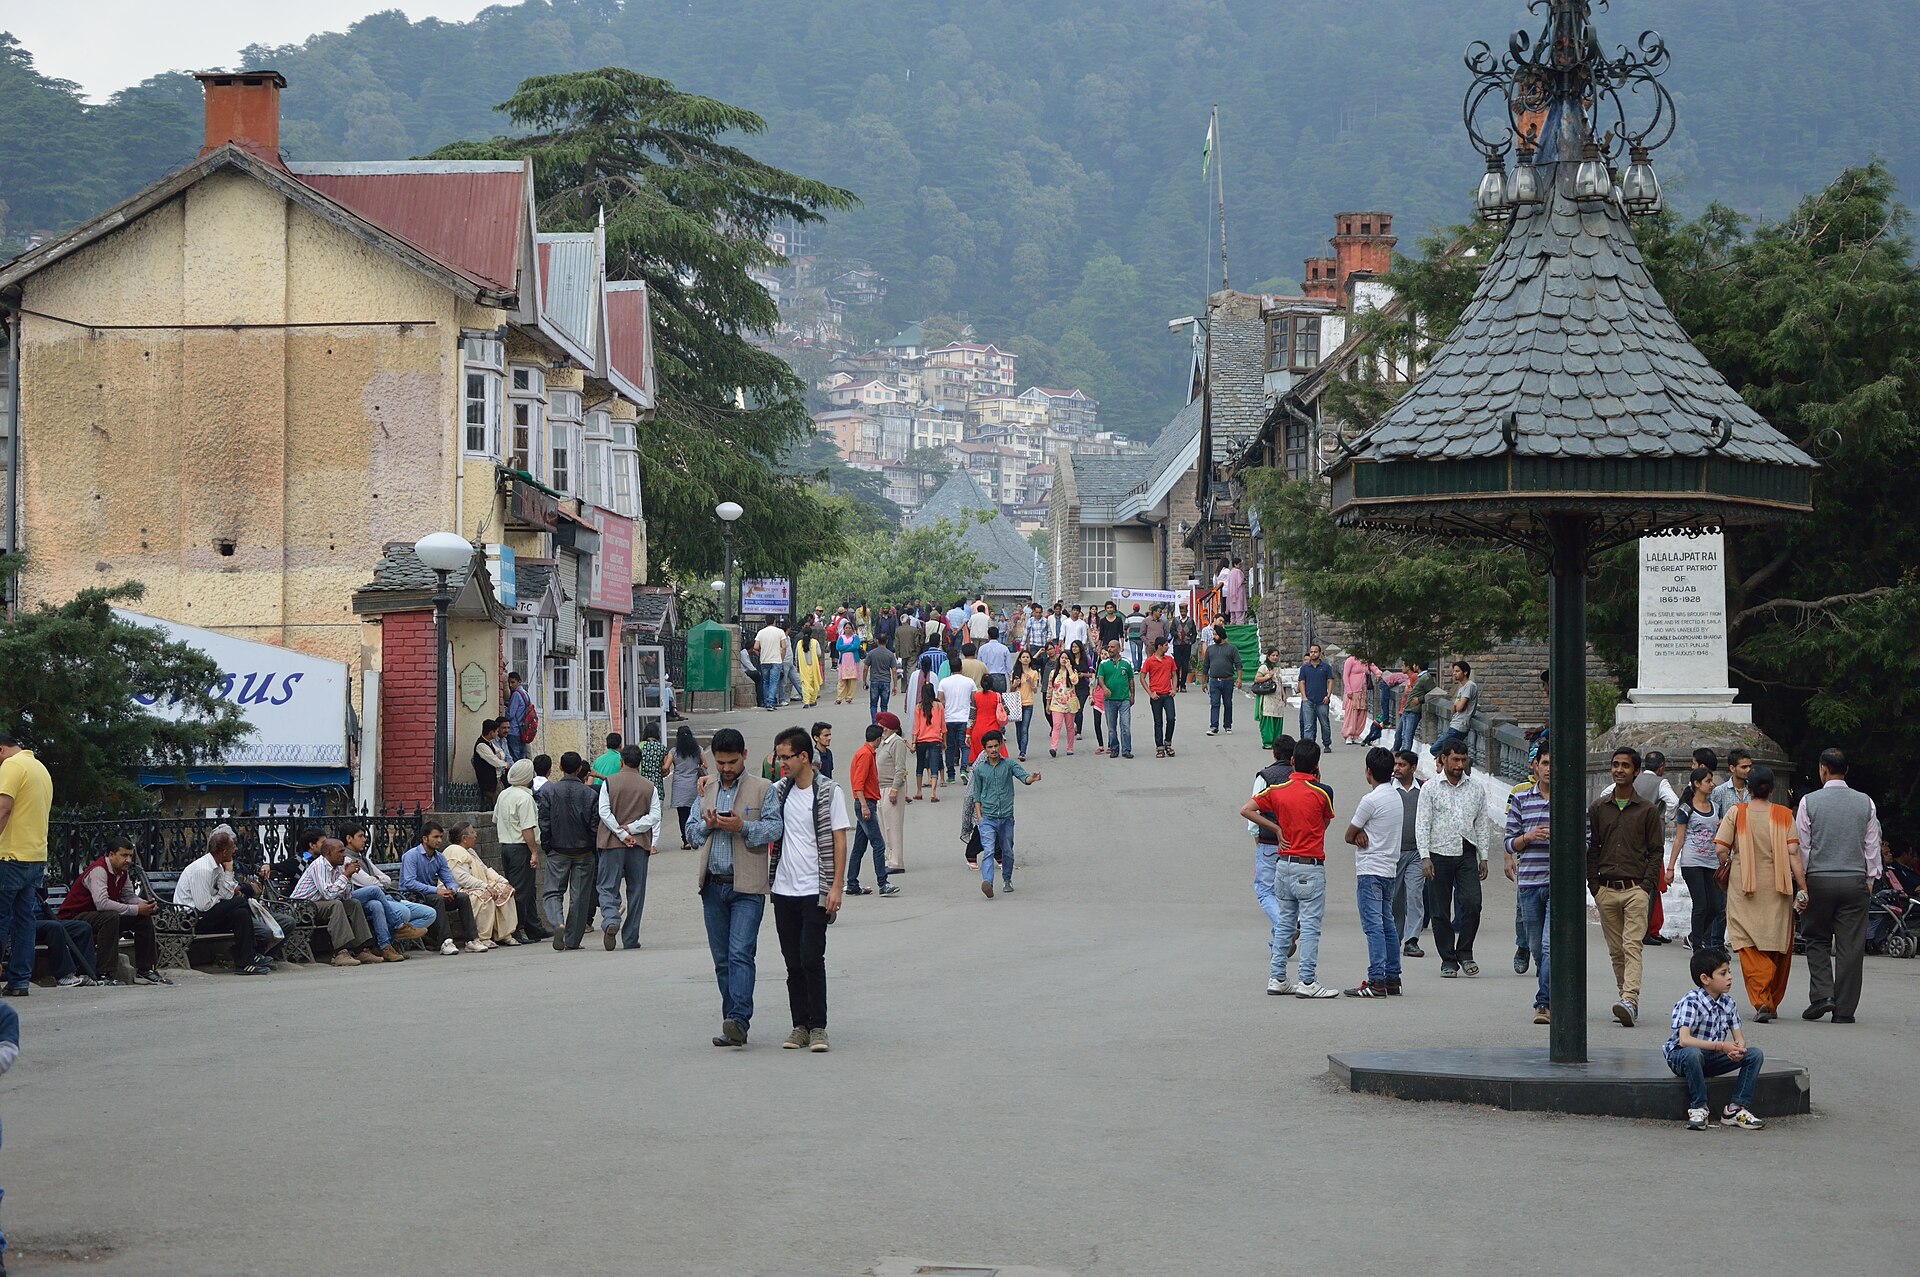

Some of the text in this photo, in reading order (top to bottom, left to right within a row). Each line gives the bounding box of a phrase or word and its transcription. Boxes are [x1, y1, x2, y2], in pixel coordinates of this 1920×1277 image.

[1646, 552, 1716, 561] LALA LAJPAT RAI
